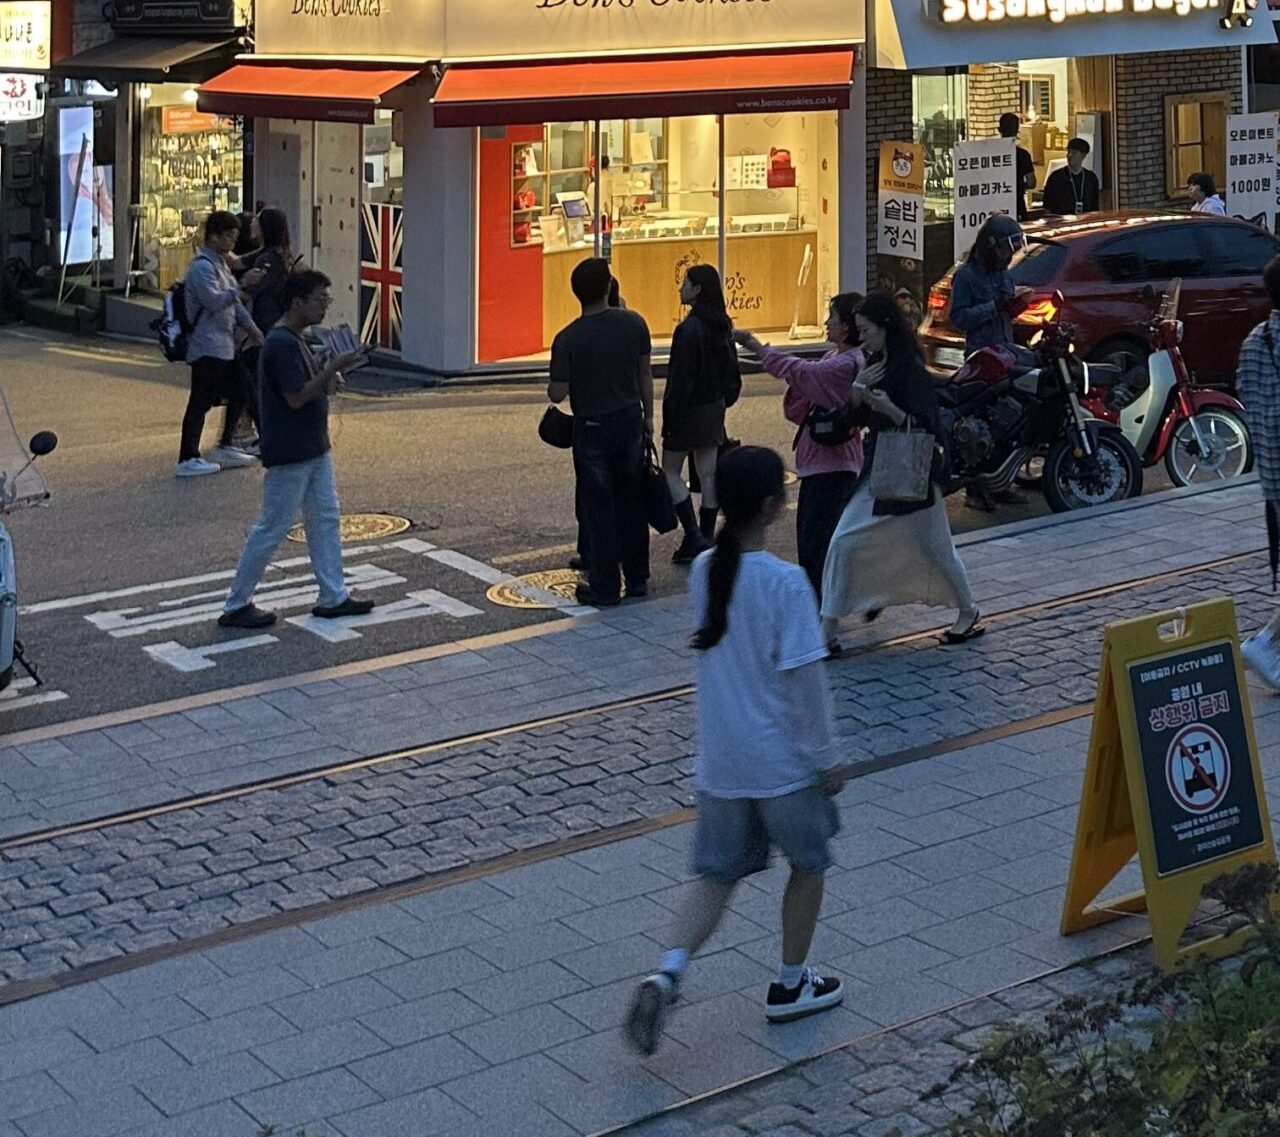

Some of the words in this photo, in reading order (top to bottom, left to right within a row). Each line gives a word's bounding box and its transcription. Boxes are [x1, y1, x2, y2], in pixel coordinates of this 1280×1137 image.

[1230, 127, 1275, 142] 오픈이벤트
[958, 154, 1013, 171] 오픈이벤트
[1230, 151, 1275, 166] 아메리카노
[958, 182, 1013, 198] 아메리카노
[1231, 177, 1271, 194] 1000원
[884, 198, 918, 223] 솥밥
[884, 225, 917, 252] 정식
[1177, 660, 1200, 673] CCTV
[1171, 685, 1191, 701] 공원
[1191, 682, 1203, 696] 내
[1149, 699, 1198, 731] 상행위
[1199, 690, 1231, 719] 금지
